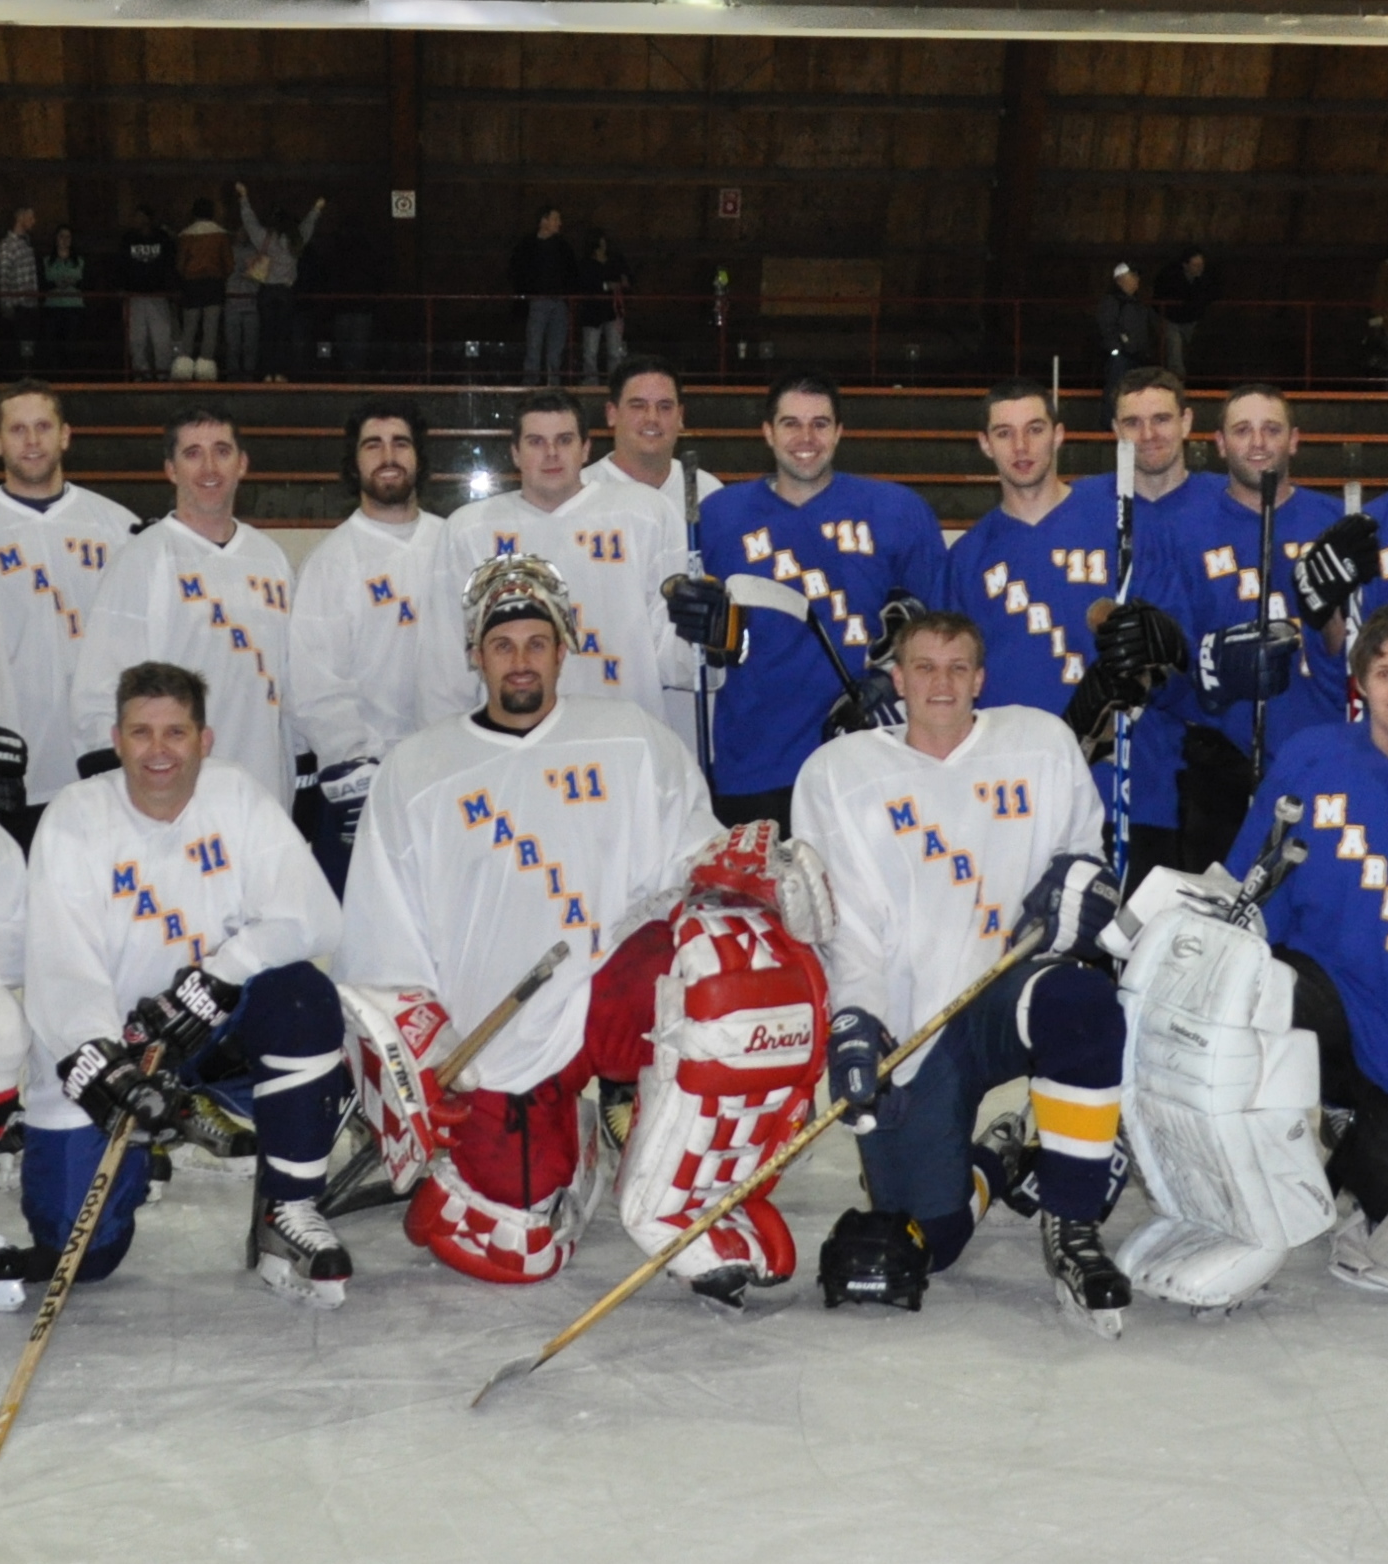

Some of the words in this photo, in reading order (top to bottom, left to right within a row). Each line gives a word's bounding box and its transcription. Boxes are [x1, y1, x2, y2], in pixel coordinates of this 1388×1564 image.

[575, 529, 626, 563] '11
[821, 520, 873, 555] '11
[742, 527, 870, 646] MARIA
[1051, 549, 1108, 584] '11
[178, 573, 280, 706] MARIA
[984, 562, 1085, 683] MARIA
[544, 762, 607, 804] '11
[974, 779, 1033, 820] '11
[185, 833, 231, 877] '11
[112, 860, 206, 967] MARI
